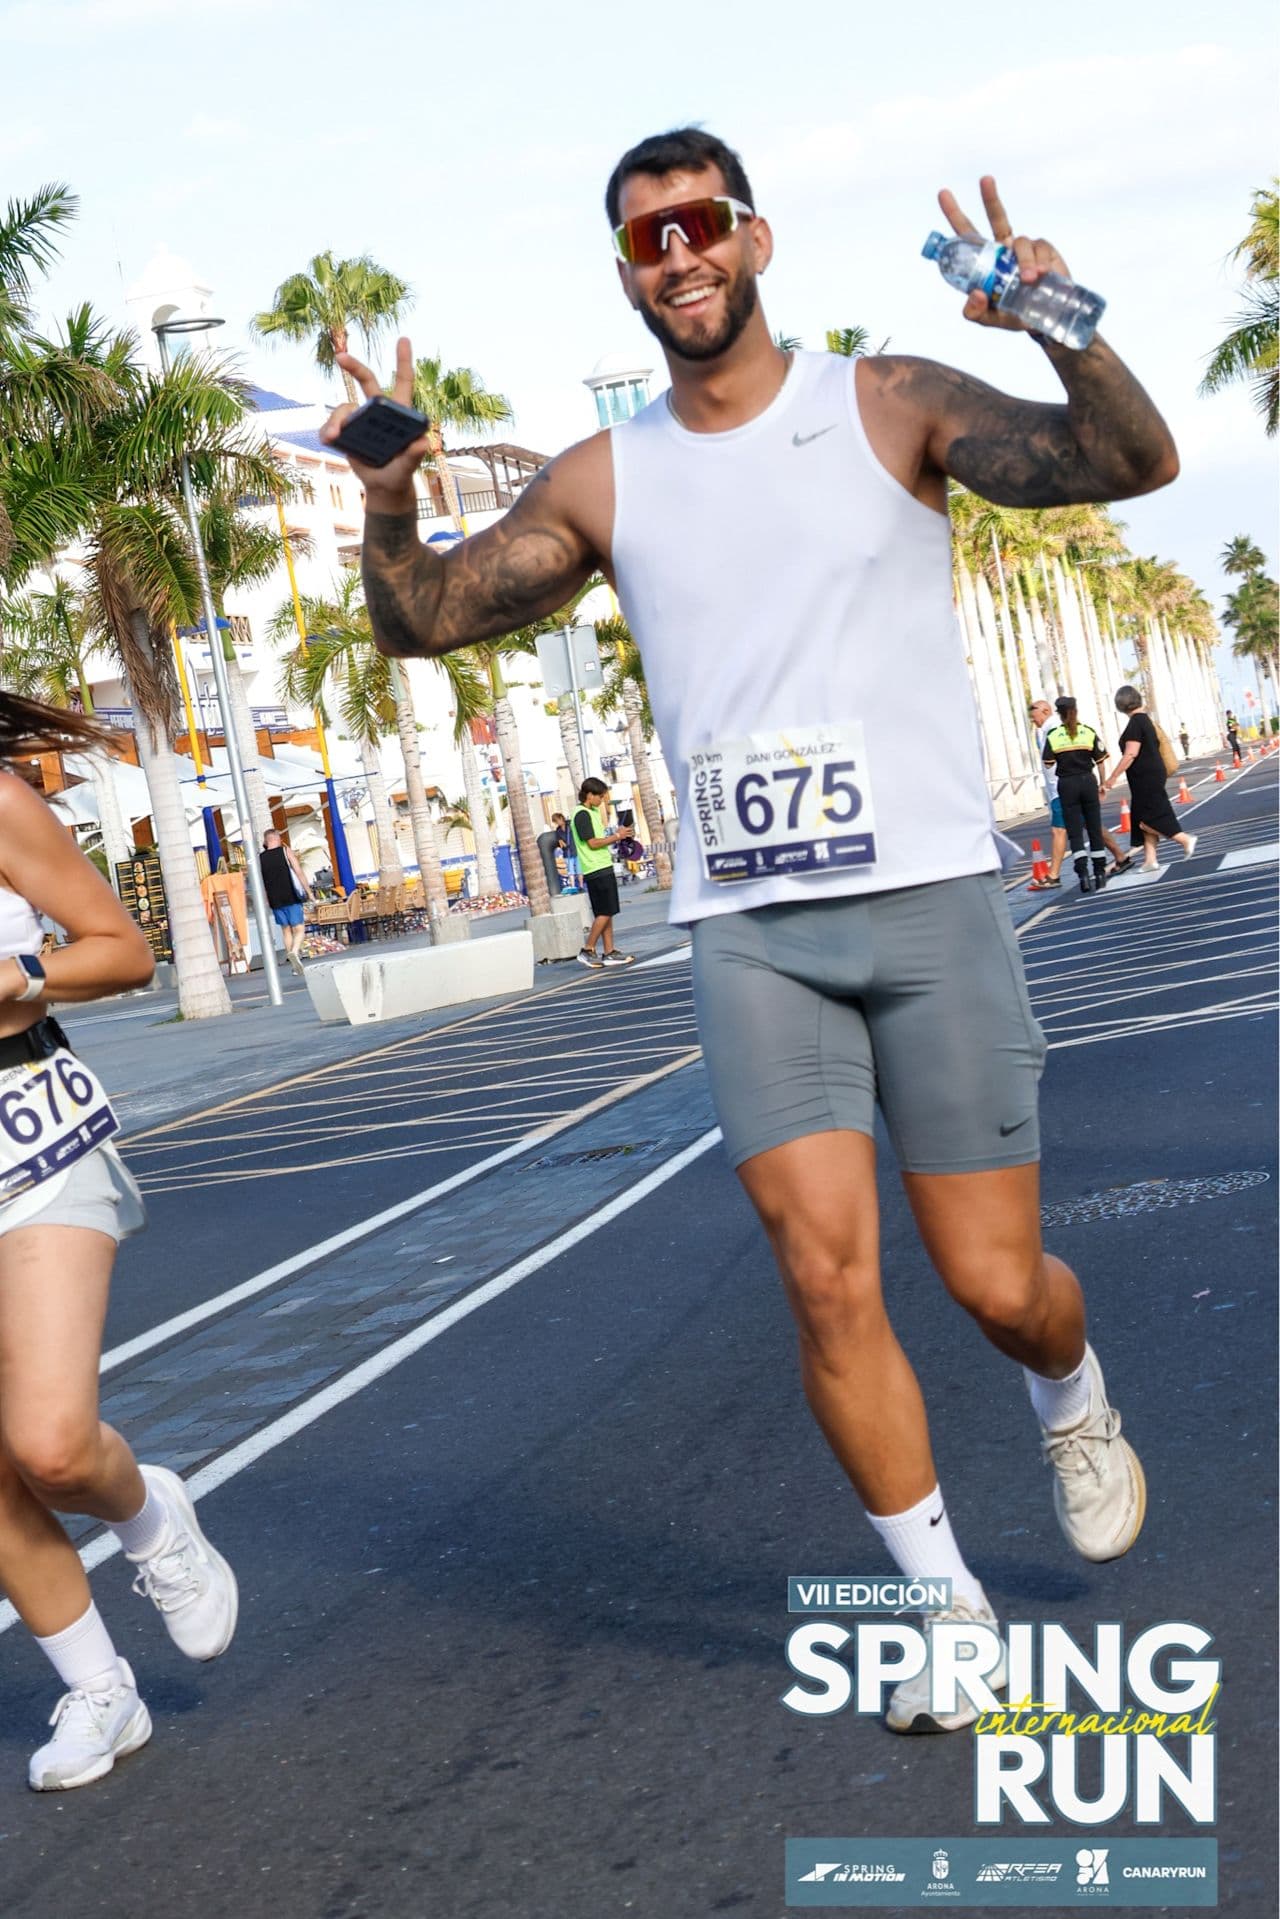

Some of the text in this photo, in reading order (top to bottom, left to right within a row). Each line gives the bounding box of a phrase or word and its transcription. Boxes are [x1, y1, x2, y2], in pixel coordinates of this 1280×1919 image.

[705, 752, 723, 763] km
[746, 752, 771, 765] DANI
[694, 770, 719, 848] SPRING
[710, 768, 727, 812] RUN
[735, 760, 863, 836] 675
[0, 1057, 93, 1145] 676
